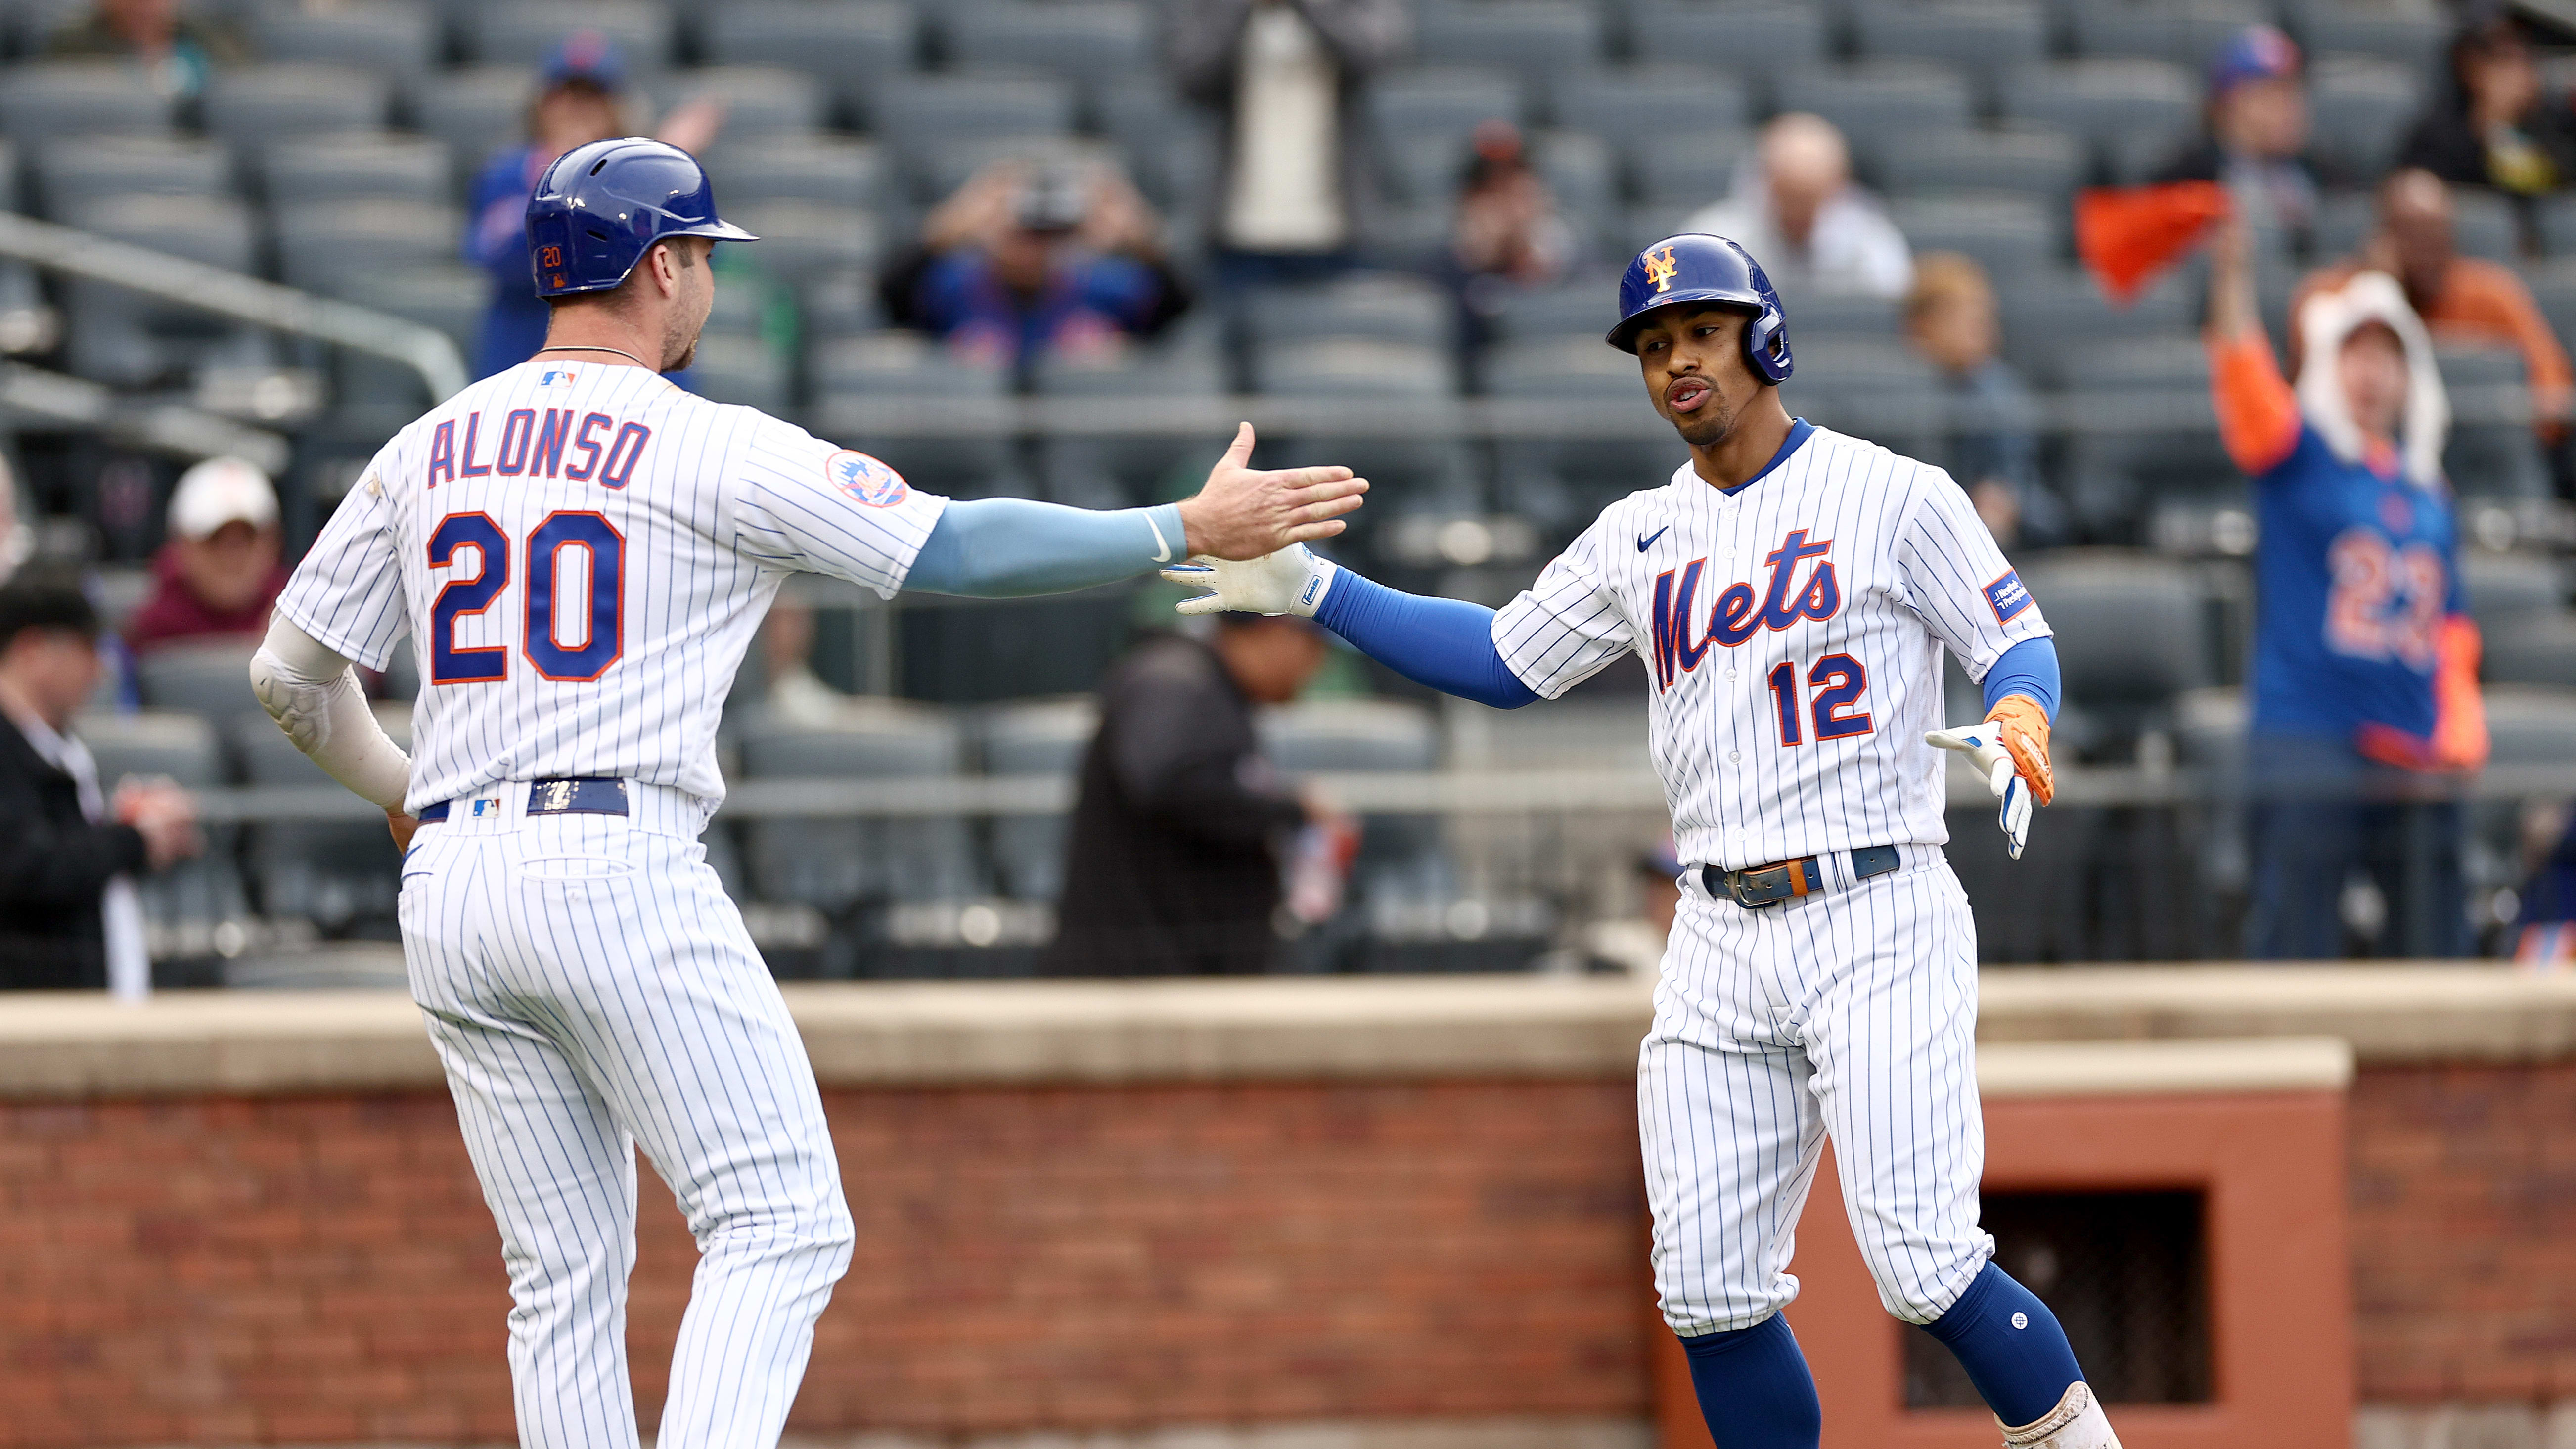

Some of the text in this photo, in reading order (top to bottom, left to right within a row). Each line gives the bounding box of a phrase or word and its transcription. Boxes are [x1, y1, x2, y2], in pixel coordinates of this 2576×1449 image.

[542, 246, 561, 268] 20
[428, 408, 651, 490] ALONSO
[427, 510, 626, 685] 20
[1652, 528, 1841, 695] Mets
[1768, 653, 1874, 747] 12
